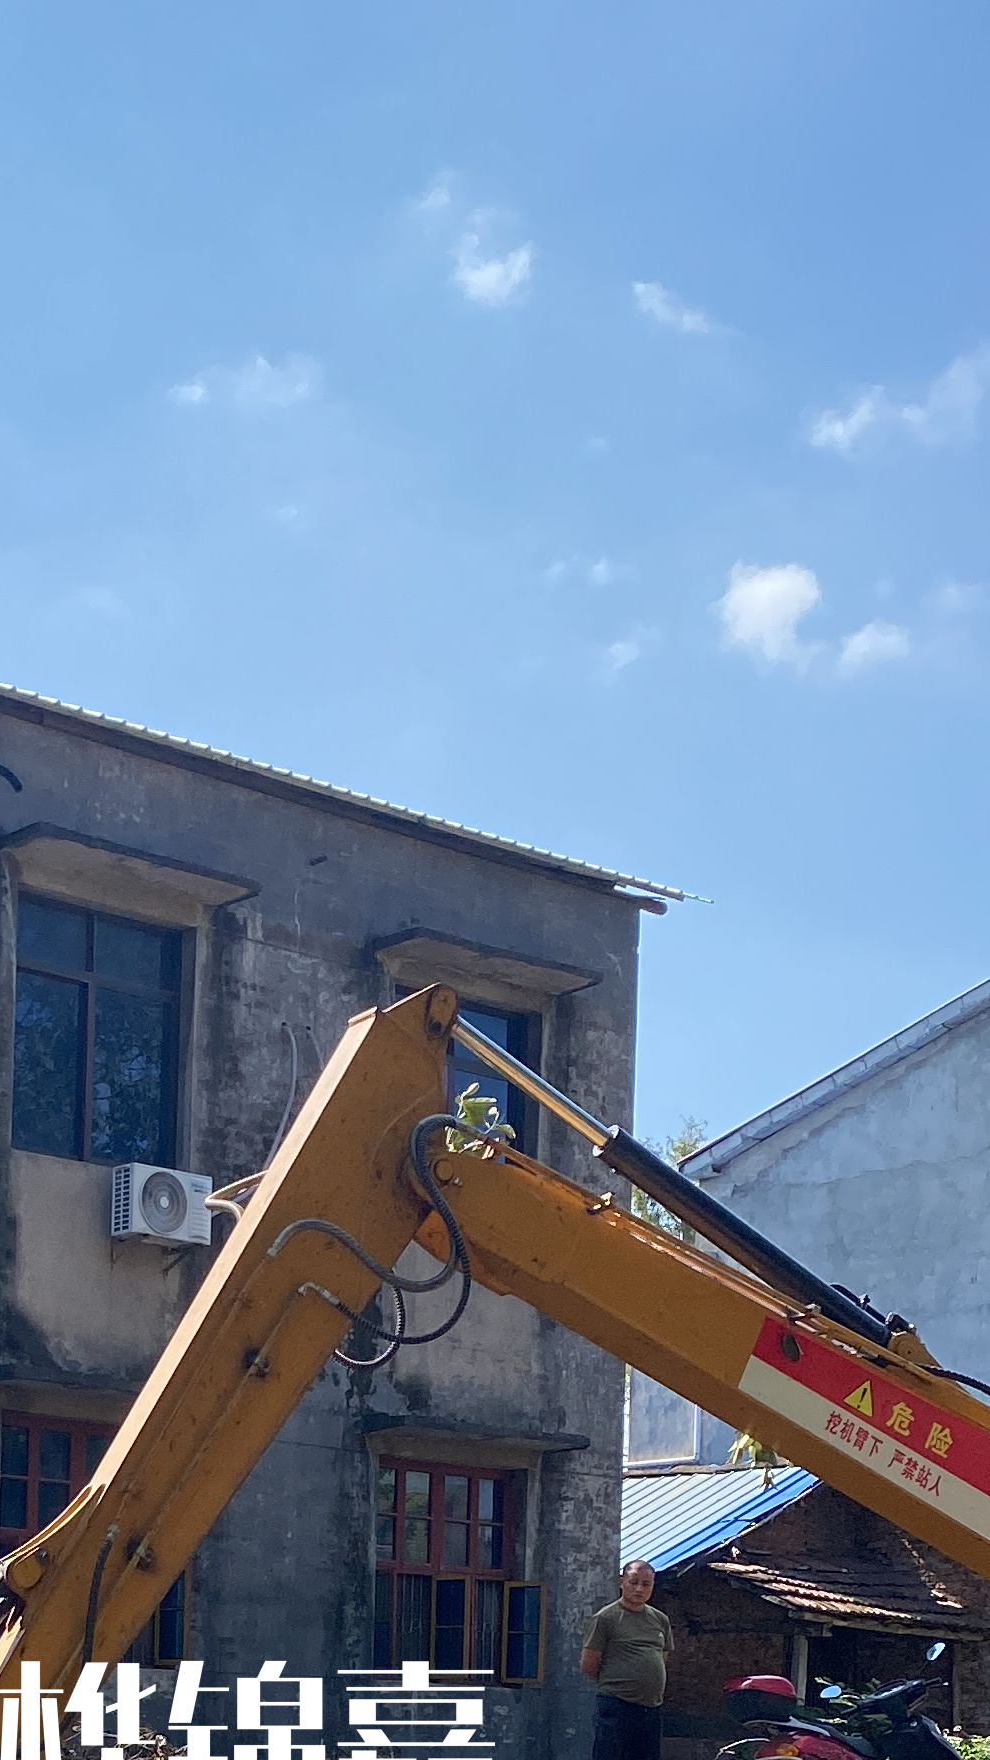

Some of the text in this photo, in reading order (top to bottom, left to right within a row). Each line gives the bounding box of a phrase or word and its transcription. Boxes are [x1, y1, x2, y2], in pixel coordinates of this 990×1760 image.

[825, 1411, 942, 1497] 挖机臂下 严禁站人
[886, 1401, 954, 1458] 危险
